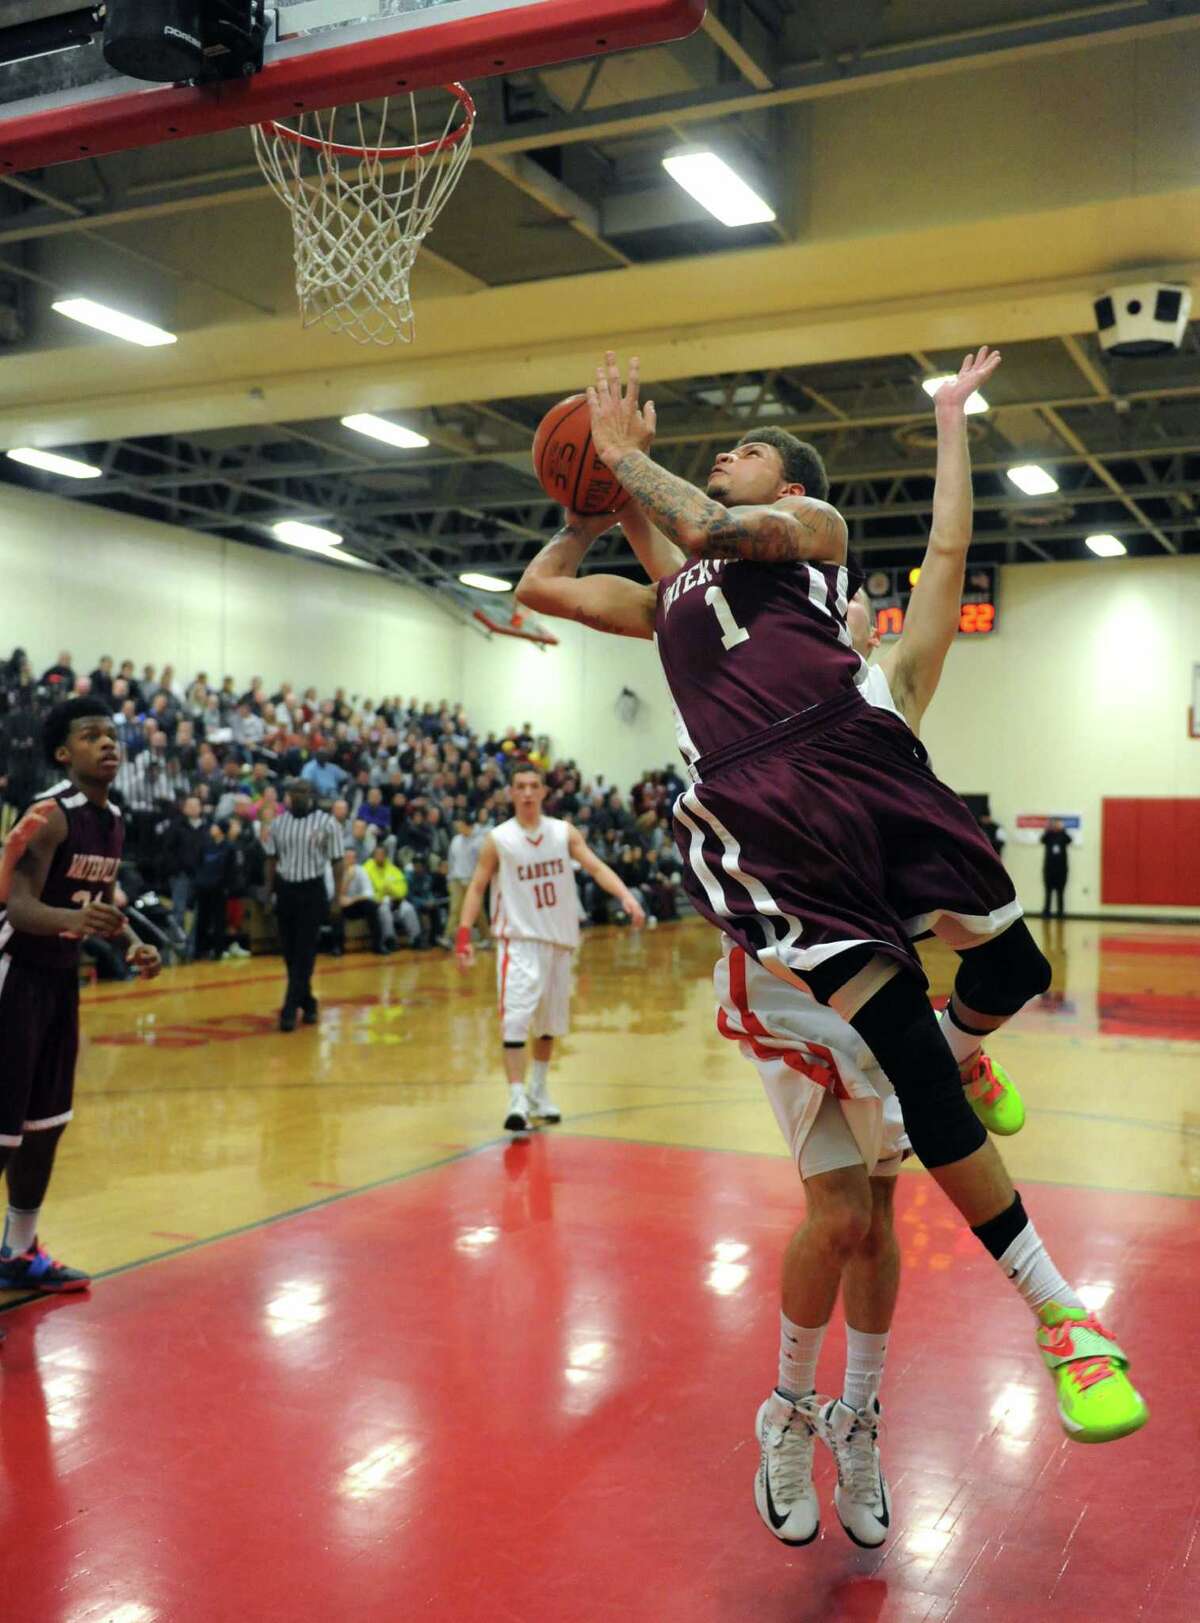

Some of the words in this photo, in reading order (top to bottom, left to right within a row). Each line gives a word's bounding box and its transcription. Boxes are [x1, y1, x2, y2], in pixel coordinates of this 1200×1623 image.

[704, 585, 750, 651] 1
[959, 602, 995, 634] 22
[517, 858, 564, 881] CADETS
[533, 882, 556, 909] 10
